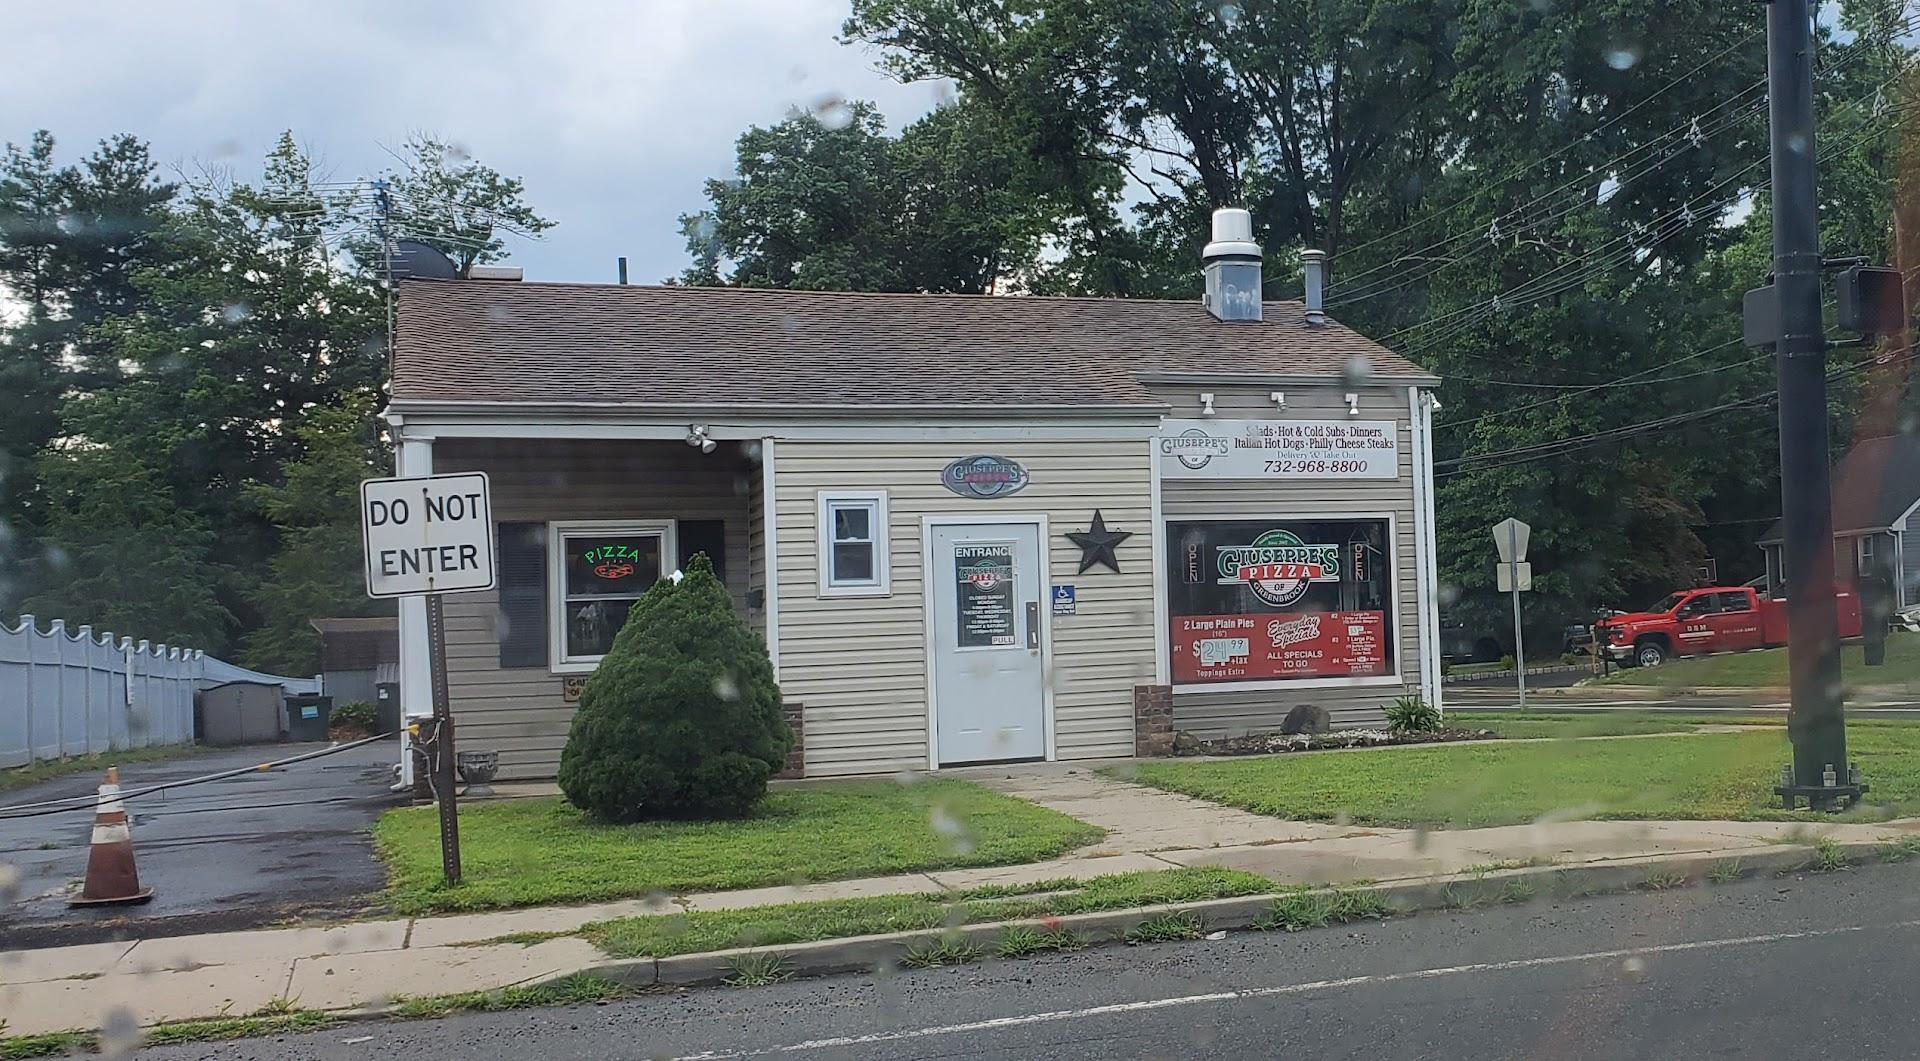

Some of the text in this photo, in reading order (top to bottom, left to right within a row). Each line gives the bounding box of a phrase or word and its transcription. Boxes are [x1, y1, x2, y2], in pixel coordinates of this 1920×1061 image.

[1246, 425, 1383, 437] Slads Hot & Cold Subs Dinners
[1160, 438, 1229, 454] GIUSEPPE'S
[1234, 437, 1394, 451] Italian Hot Dogs Philly Cheese Steaks
[1277, 450, 1307, 460] Delivery
[1323, 451, 1340, 459] Take
[1342, 451, 1356, 459] Out
[953, 464, 1018, 480] GIUSEPPE'S
[1263, 460, 1368, 473] 732-968-8800
[370, 494, 481, 526] DO NOT
[584, 546, 639, 564] PIZZA
[956, 547, 1013, 558] ENTRANCE
[380, 544, 479, 577] ENTER
[1189, 543, 1198, 582] OPEN
[1217, 548, 1339, 578] GIUSEPPE'S
[1355, 543, 1364, 581] OPEN
[1249, 565, 1311, 579] PIZZA
[1253, 581, 1307, 603] GREENBROOK
[1274, 583, 1285, 592] OF
[1184, 618, 1255, 630] 2 Large Plain Pies
[1267, 614, 1320, 637] Everyday
[1272, 626, 1320, 649] Specials
[1267, 650, 1323, 660] ALL SPECIALS
[1283, 660, 1308, 668] TO GO
[1196, 669, 1227, 677] Toppings
